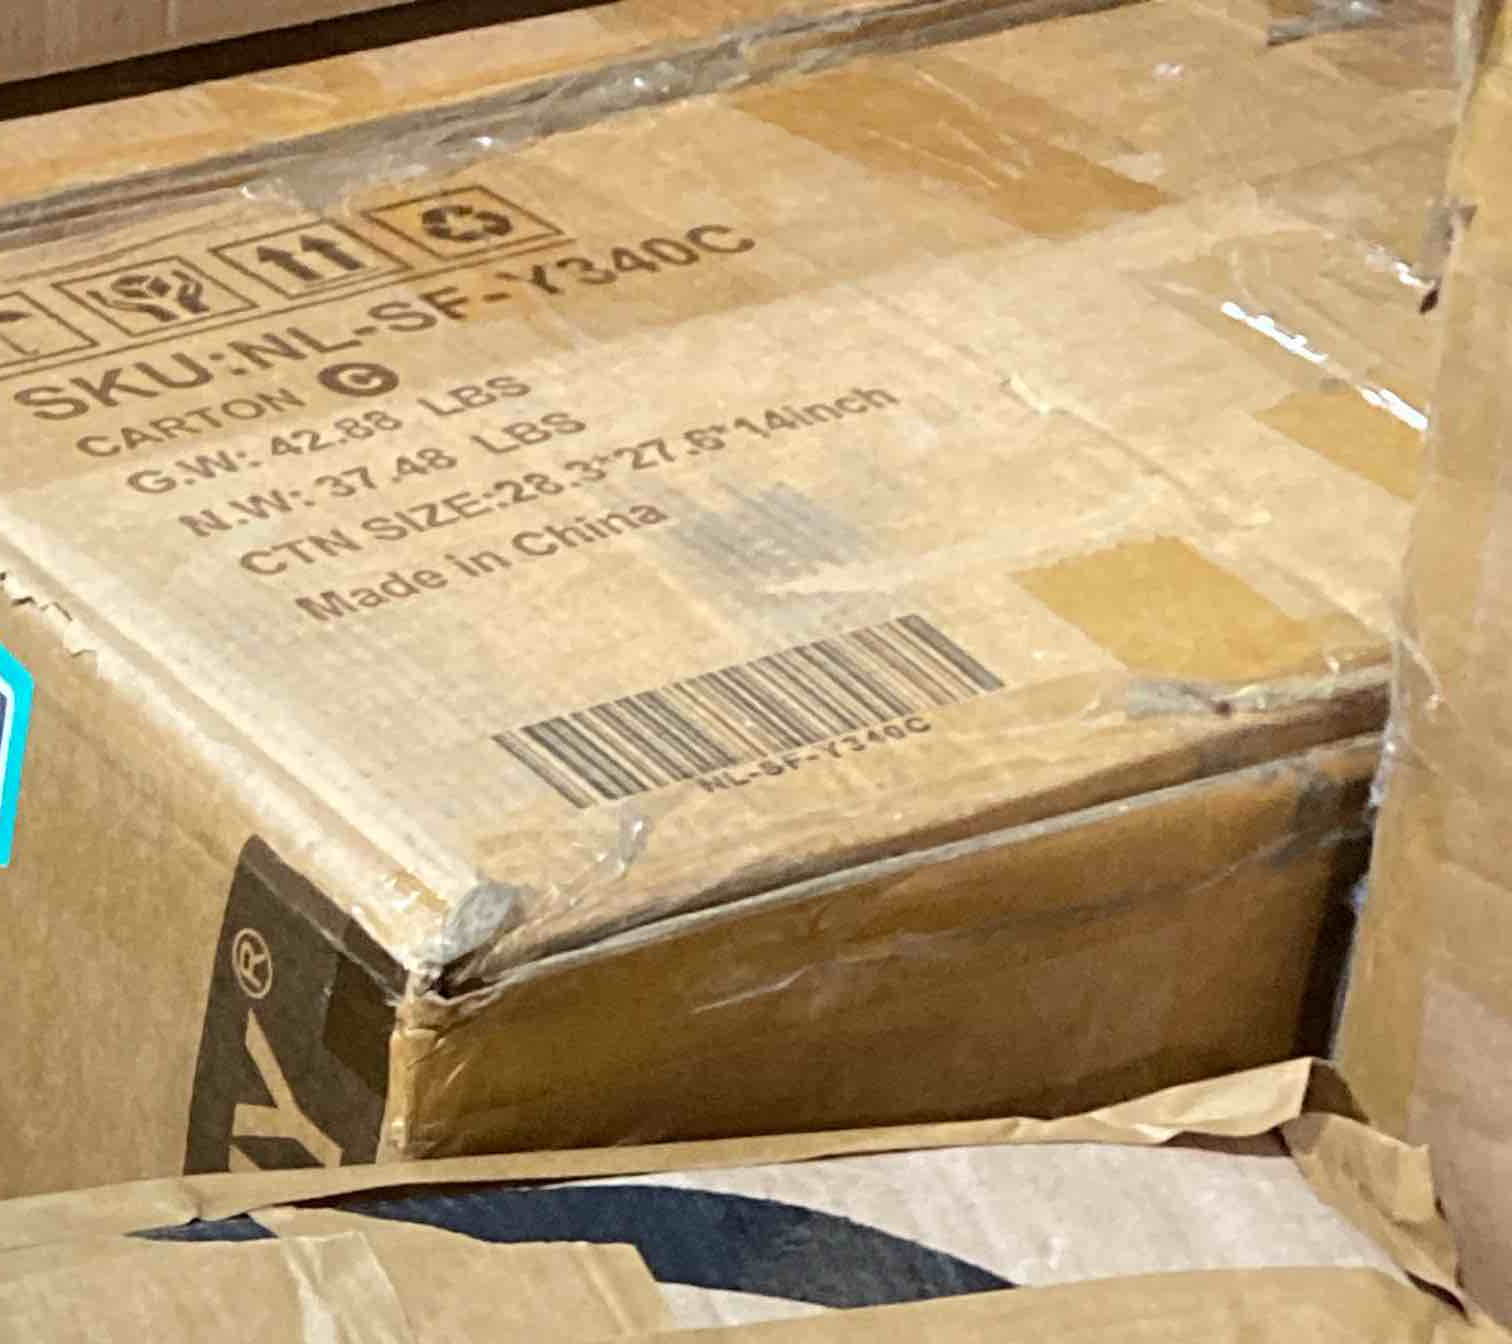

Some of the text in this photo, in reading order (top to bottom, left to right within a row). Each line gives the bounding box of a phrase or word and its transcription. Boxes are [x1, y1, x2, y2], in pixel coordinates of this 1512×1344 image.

[13, 223, 756, 424] SKU:NL-SF-Y340C
[75, 388, 296, 459] CARTON
[127, 375, 533, 497] G.W: 42.88 LBS
[178, 411, 588, 538] N.W: 37.48 LBS
[239, 529, 355, 578] CTN
[296, 502, 669, 624] Made in China
[697, 715, 933, 794] NL-SF-Y340C
